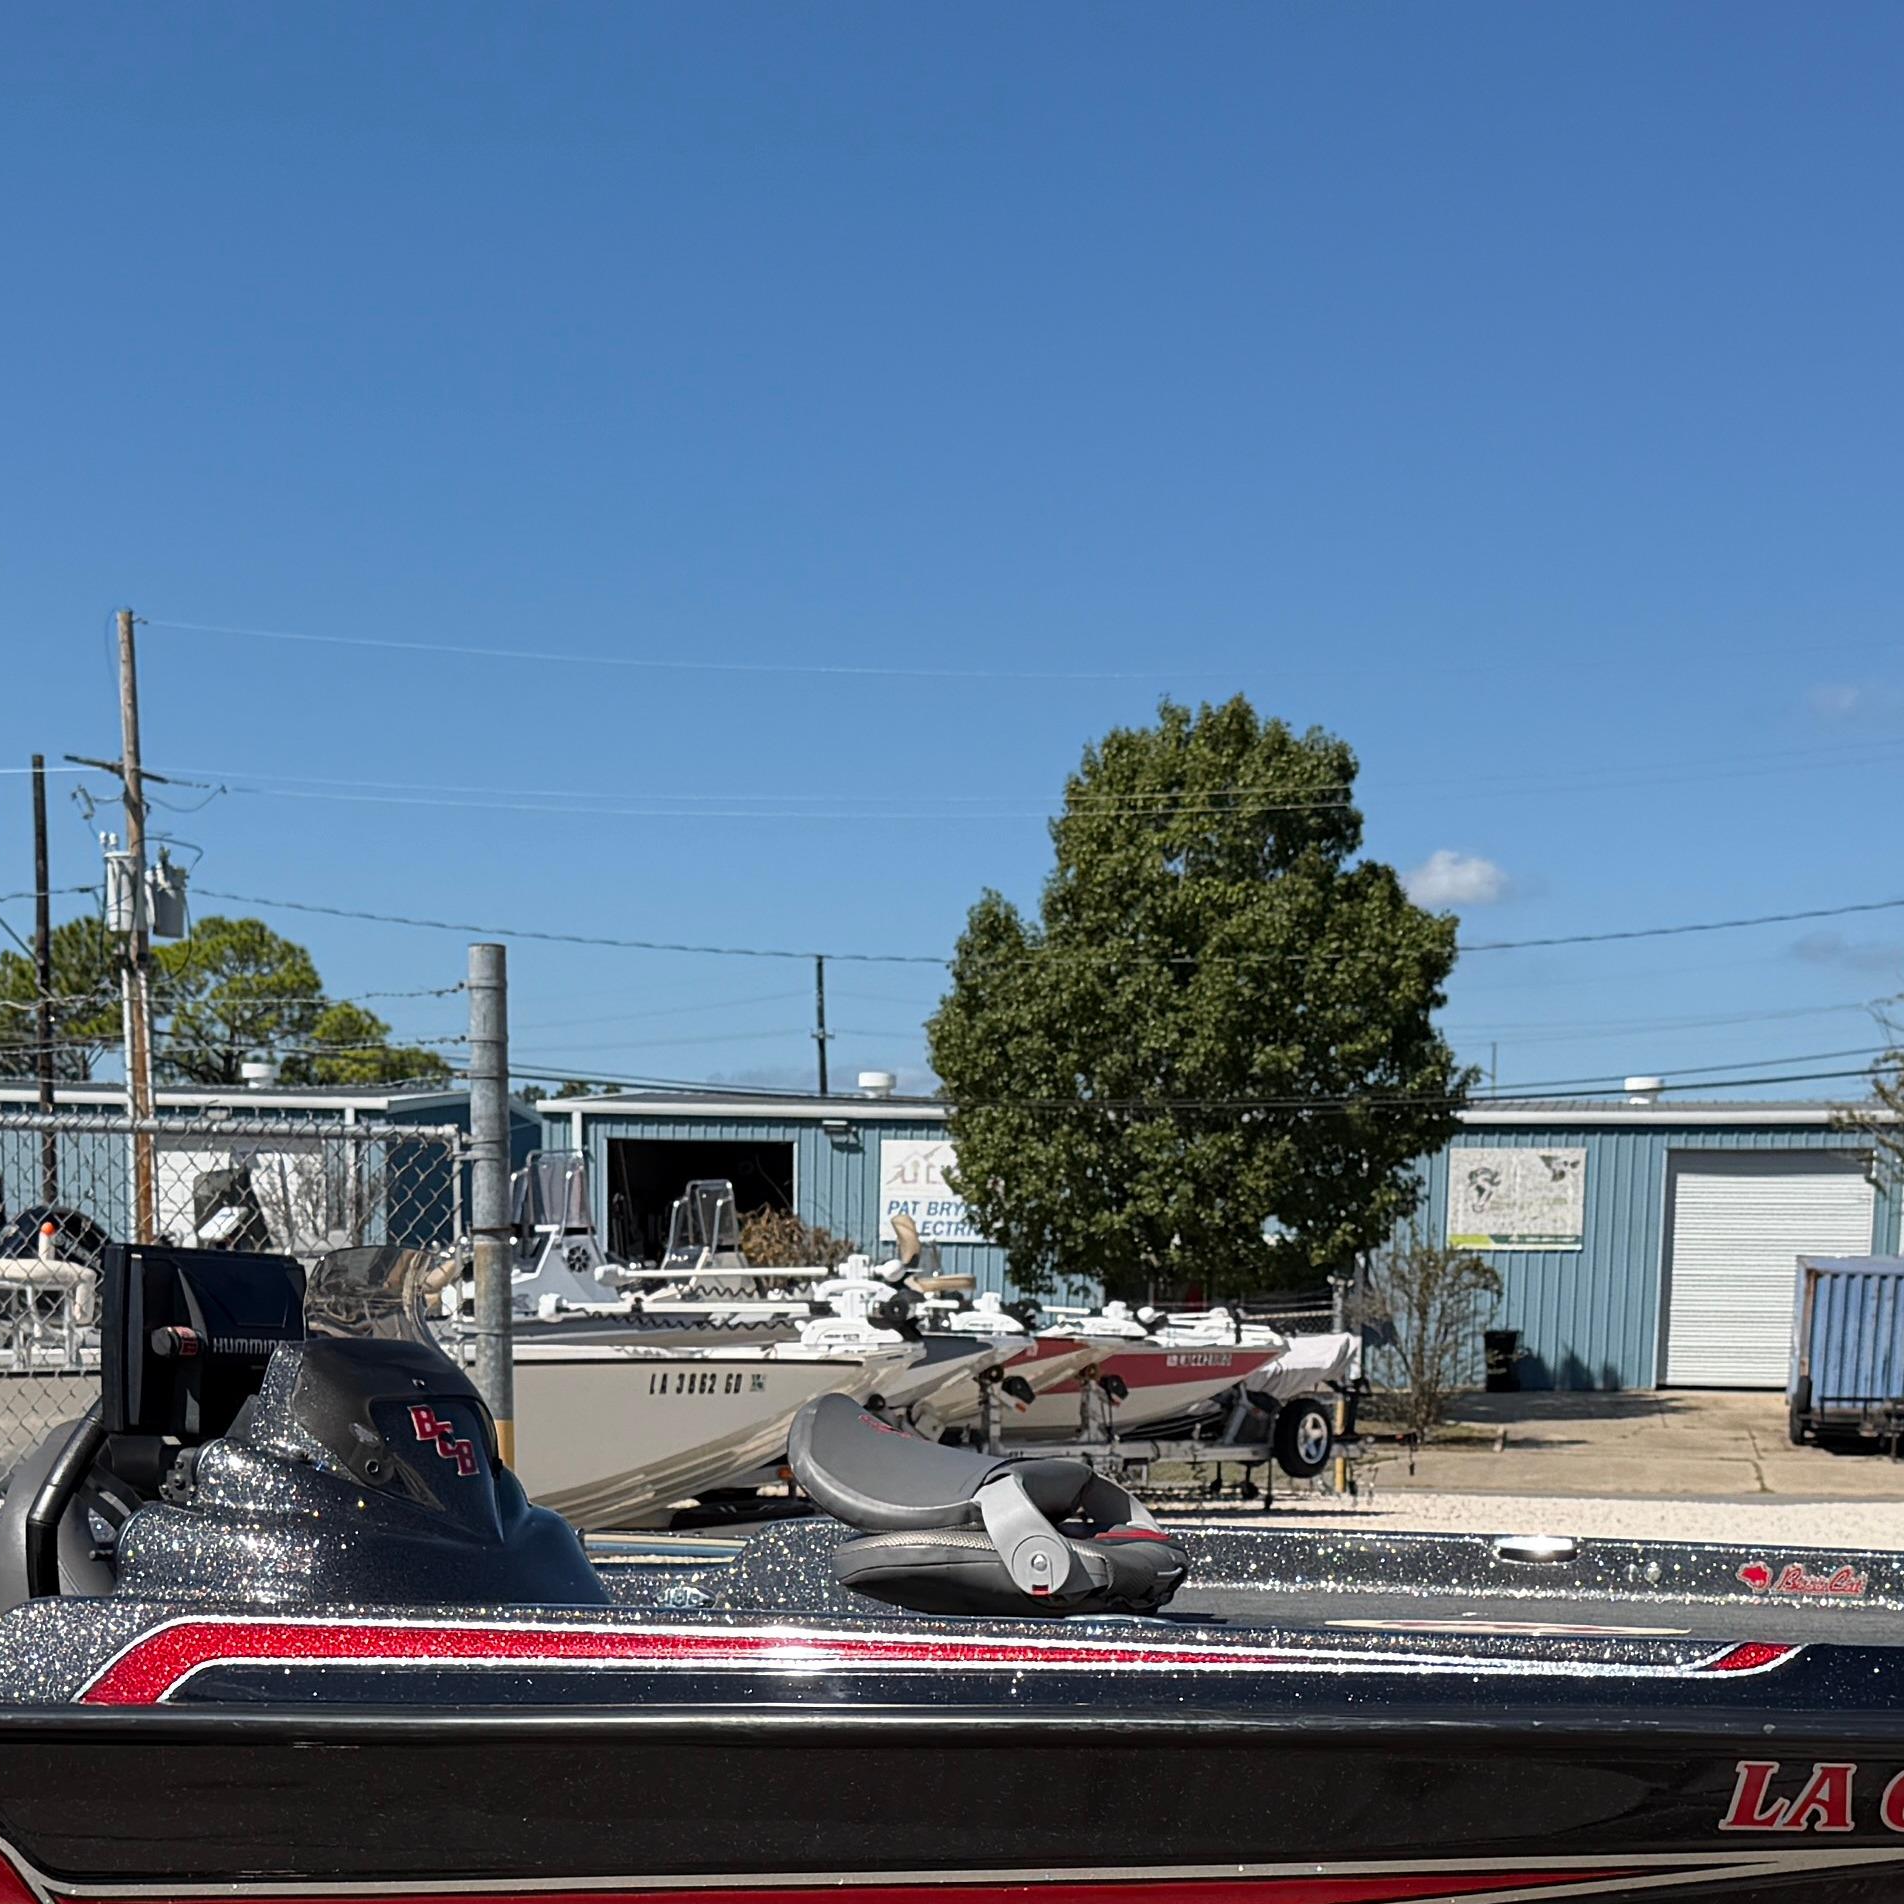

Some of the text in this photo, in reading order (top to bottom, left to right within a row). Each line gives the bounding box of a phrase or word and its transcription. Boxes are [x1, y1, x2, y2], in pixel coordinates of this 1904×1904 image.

[887, 1200, 920, 1215] PAT
[649, 1373, 668, 1395] LA
[1718, 1761, 1857, 1831] LA
